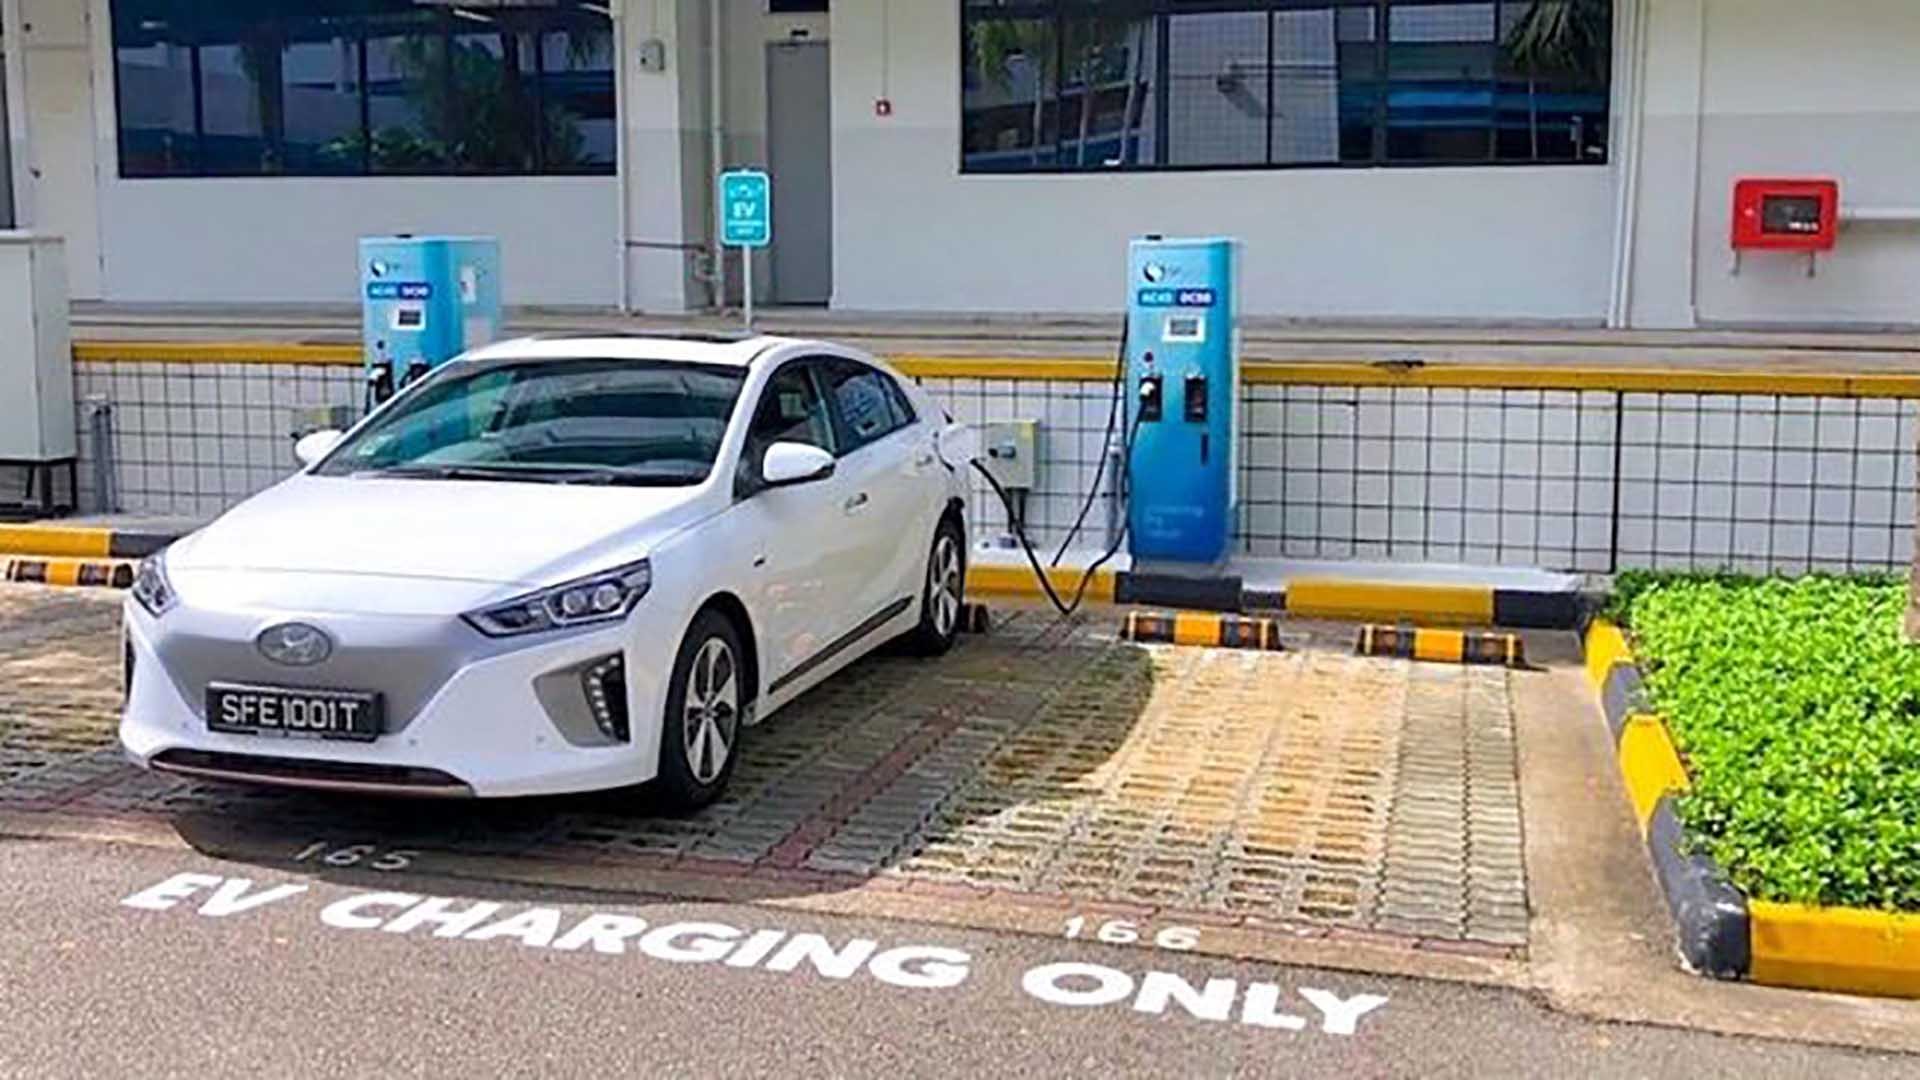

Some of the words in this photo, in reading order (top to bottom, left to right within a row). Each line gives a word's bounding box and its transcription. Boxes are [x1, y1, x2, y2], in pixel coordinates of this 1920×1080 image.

[221, 694, 359, 731] SFE1001T
[294, 841, 420, 869] 165
[1064, 915, 1202, 950] 166
[120, 872, 309, 917] EV
[320, 891, 971, 988] CHARGING
[1022, 961, 1389, 1035] ONLY
